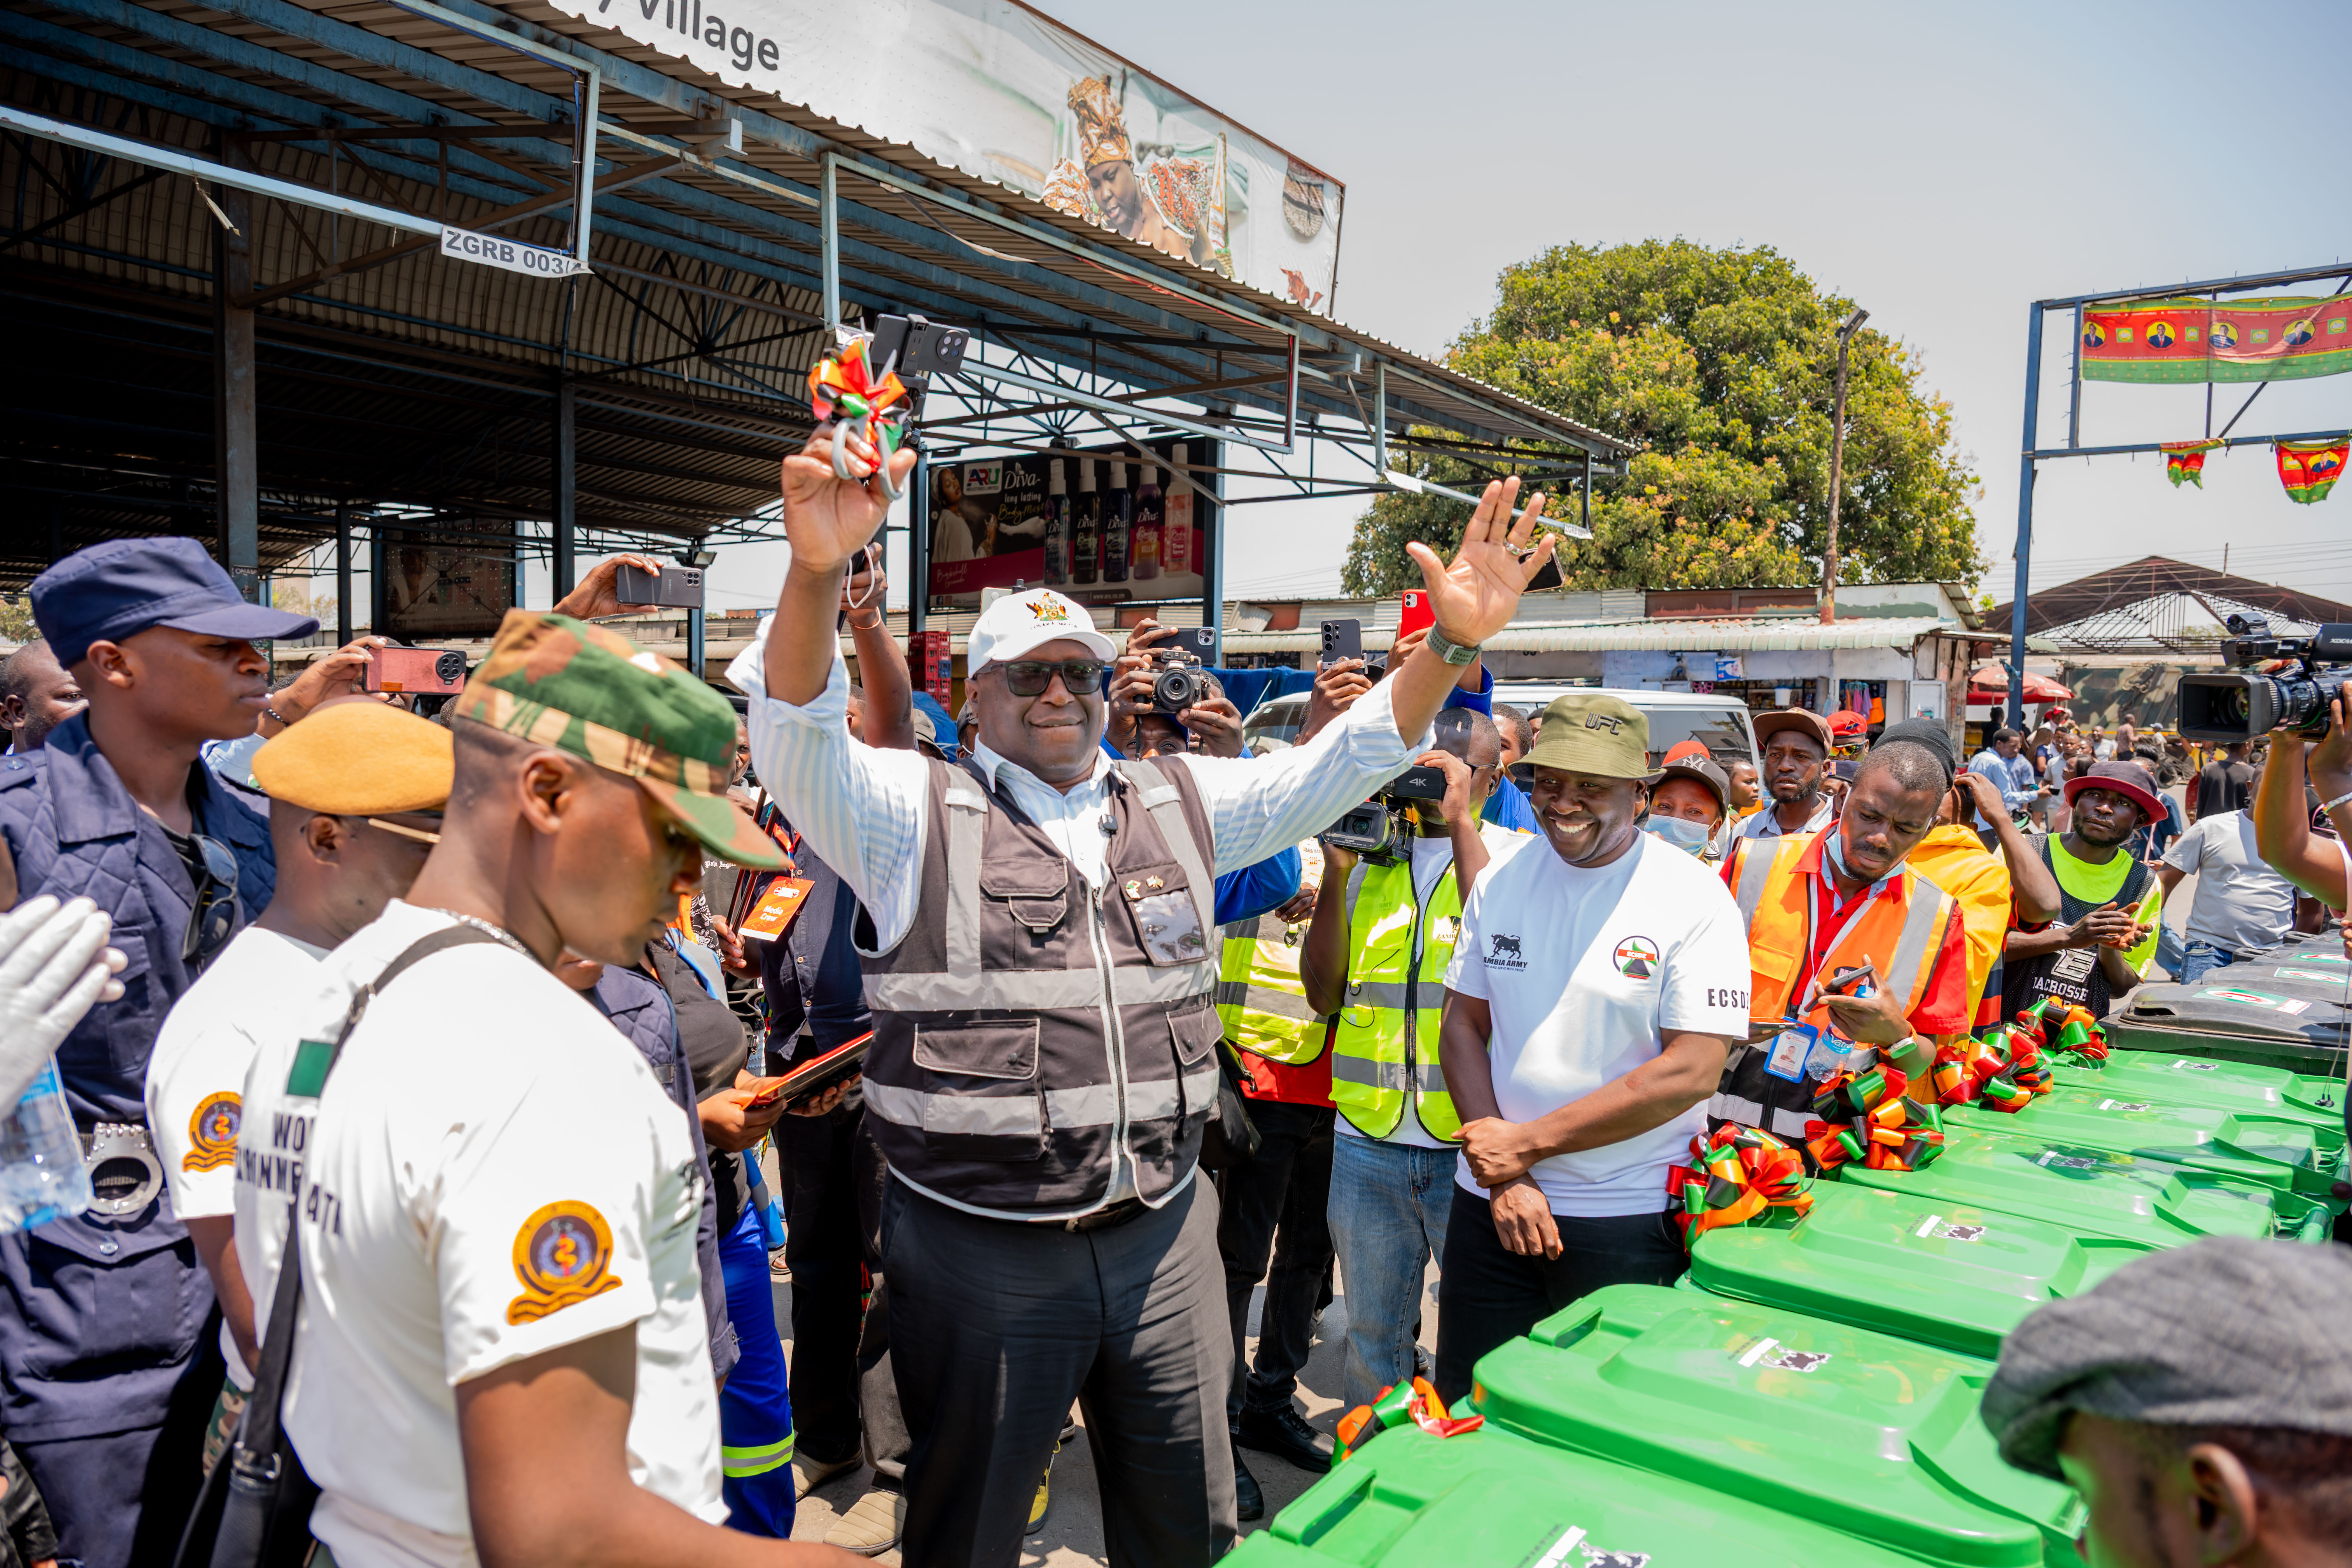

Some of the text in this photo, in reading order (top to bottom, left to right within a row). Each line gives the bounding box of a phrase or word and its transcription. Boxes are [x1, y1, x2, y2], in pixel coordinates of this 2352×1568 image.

[446, 230, 514, 263] ZGRB
[966, 468, 1001, 487] ARU
[1004, 468, 1041, 490] Diva
[1004, 492, 1041, 504] long lasting
[1585, 712, 1623, 736] UFC
[1409, 778, 1427, 787] 4K
[763, 905, 784, 915] Media
[760, 912, 777, 922] Crew
[1483, 956, 1528, 968] AMBIA ARMY
